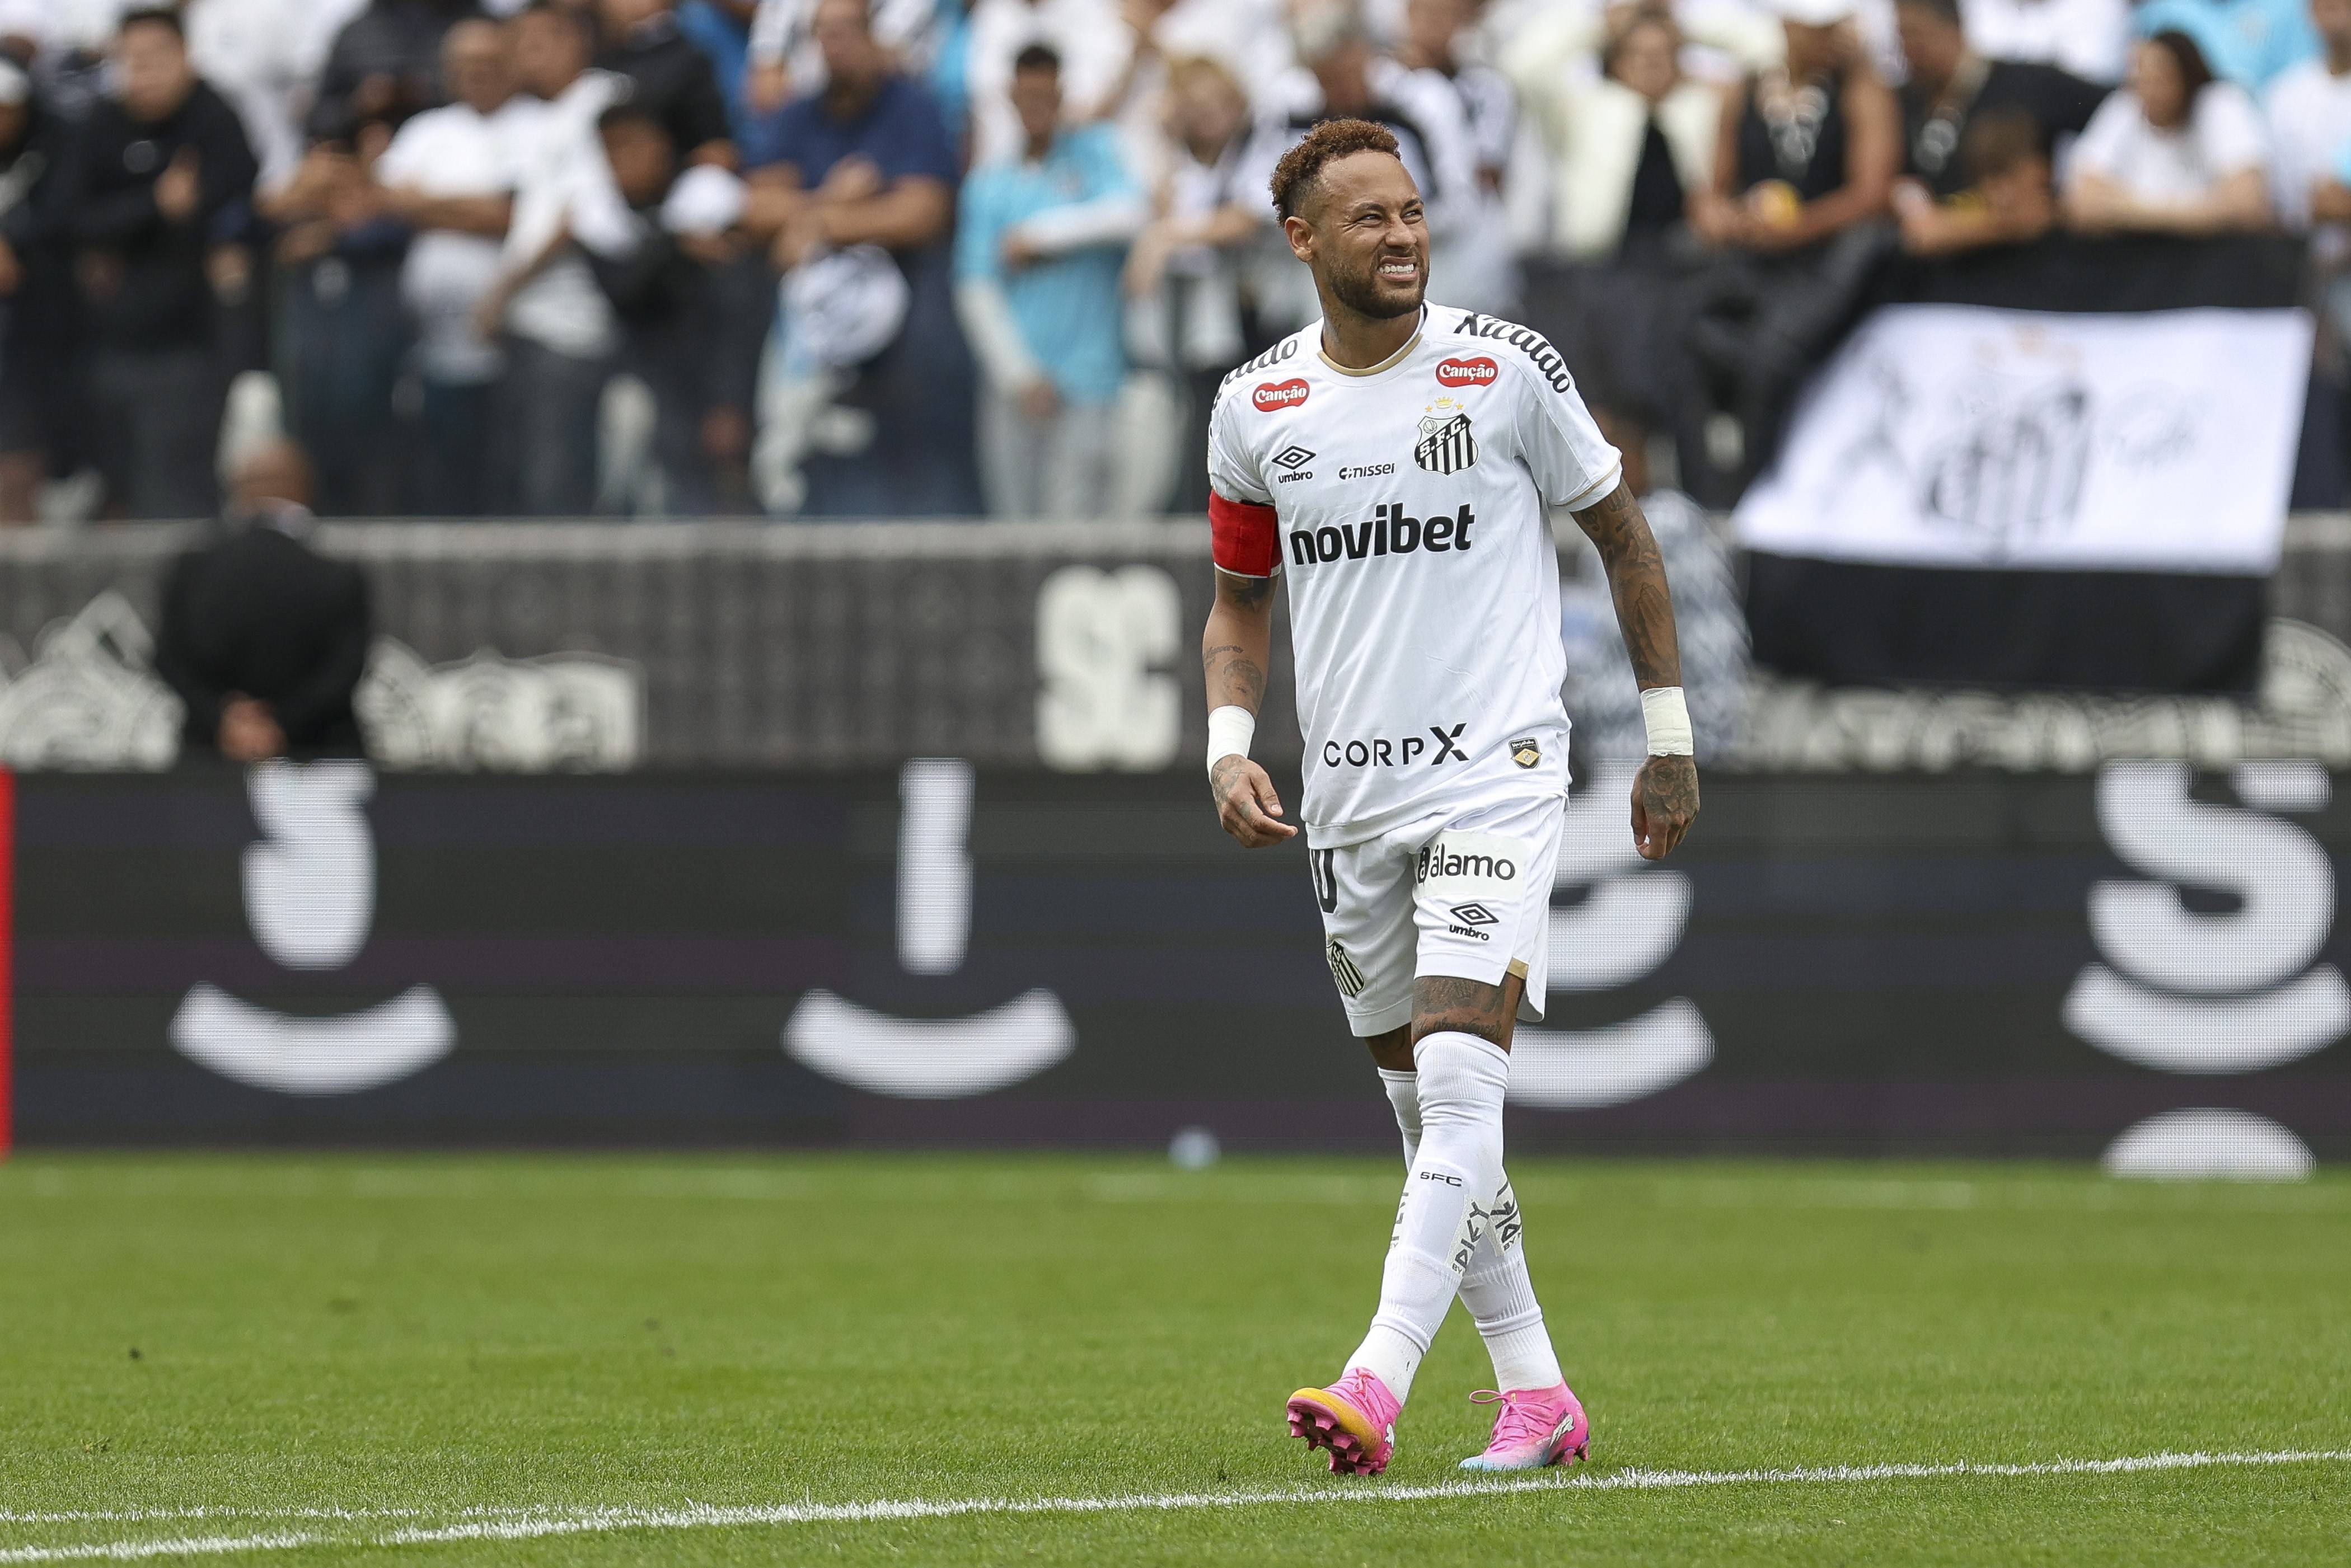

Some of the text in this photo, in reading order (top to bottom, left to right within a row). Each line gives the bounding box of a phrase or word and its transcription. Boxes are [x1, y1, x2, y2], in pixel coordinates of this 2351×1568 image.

[1439, 364, 1495, 381] Canção
[1255, 385, 1307, 403] Canção
[1278, 471, 1313, 483] umbro
[1289, 502, 1476, 565] novibet
[1430, 843, 1516, 881] álamo
[1449, 924, 1490, 941] umbro
[1420, 1171, 1462, 1187] SFC
